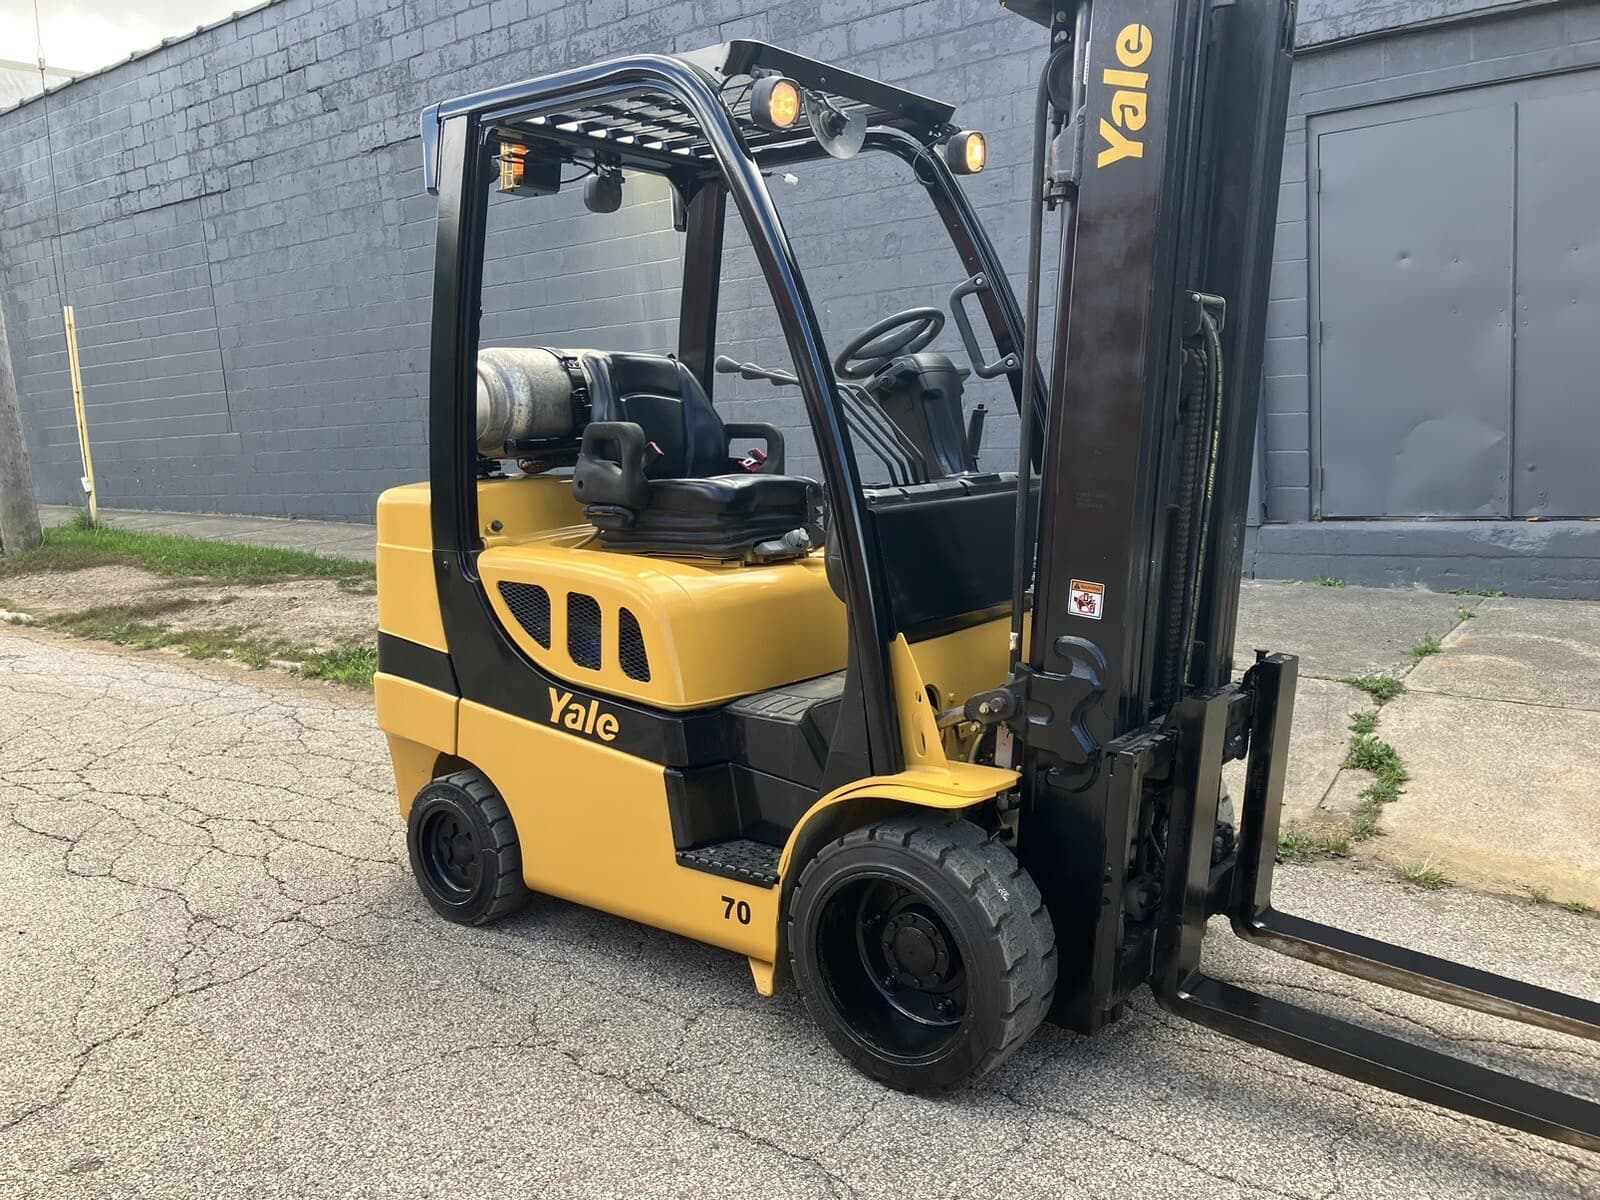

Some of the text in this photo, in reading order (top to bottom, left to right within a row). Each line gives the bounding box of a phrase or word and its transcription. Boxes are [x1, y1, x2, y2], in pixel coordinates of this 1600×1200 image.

[1097, 23, 1153, 169] Yale
[548, 686, 620, 741] Yale
[721, 895, 751, 925] 70
